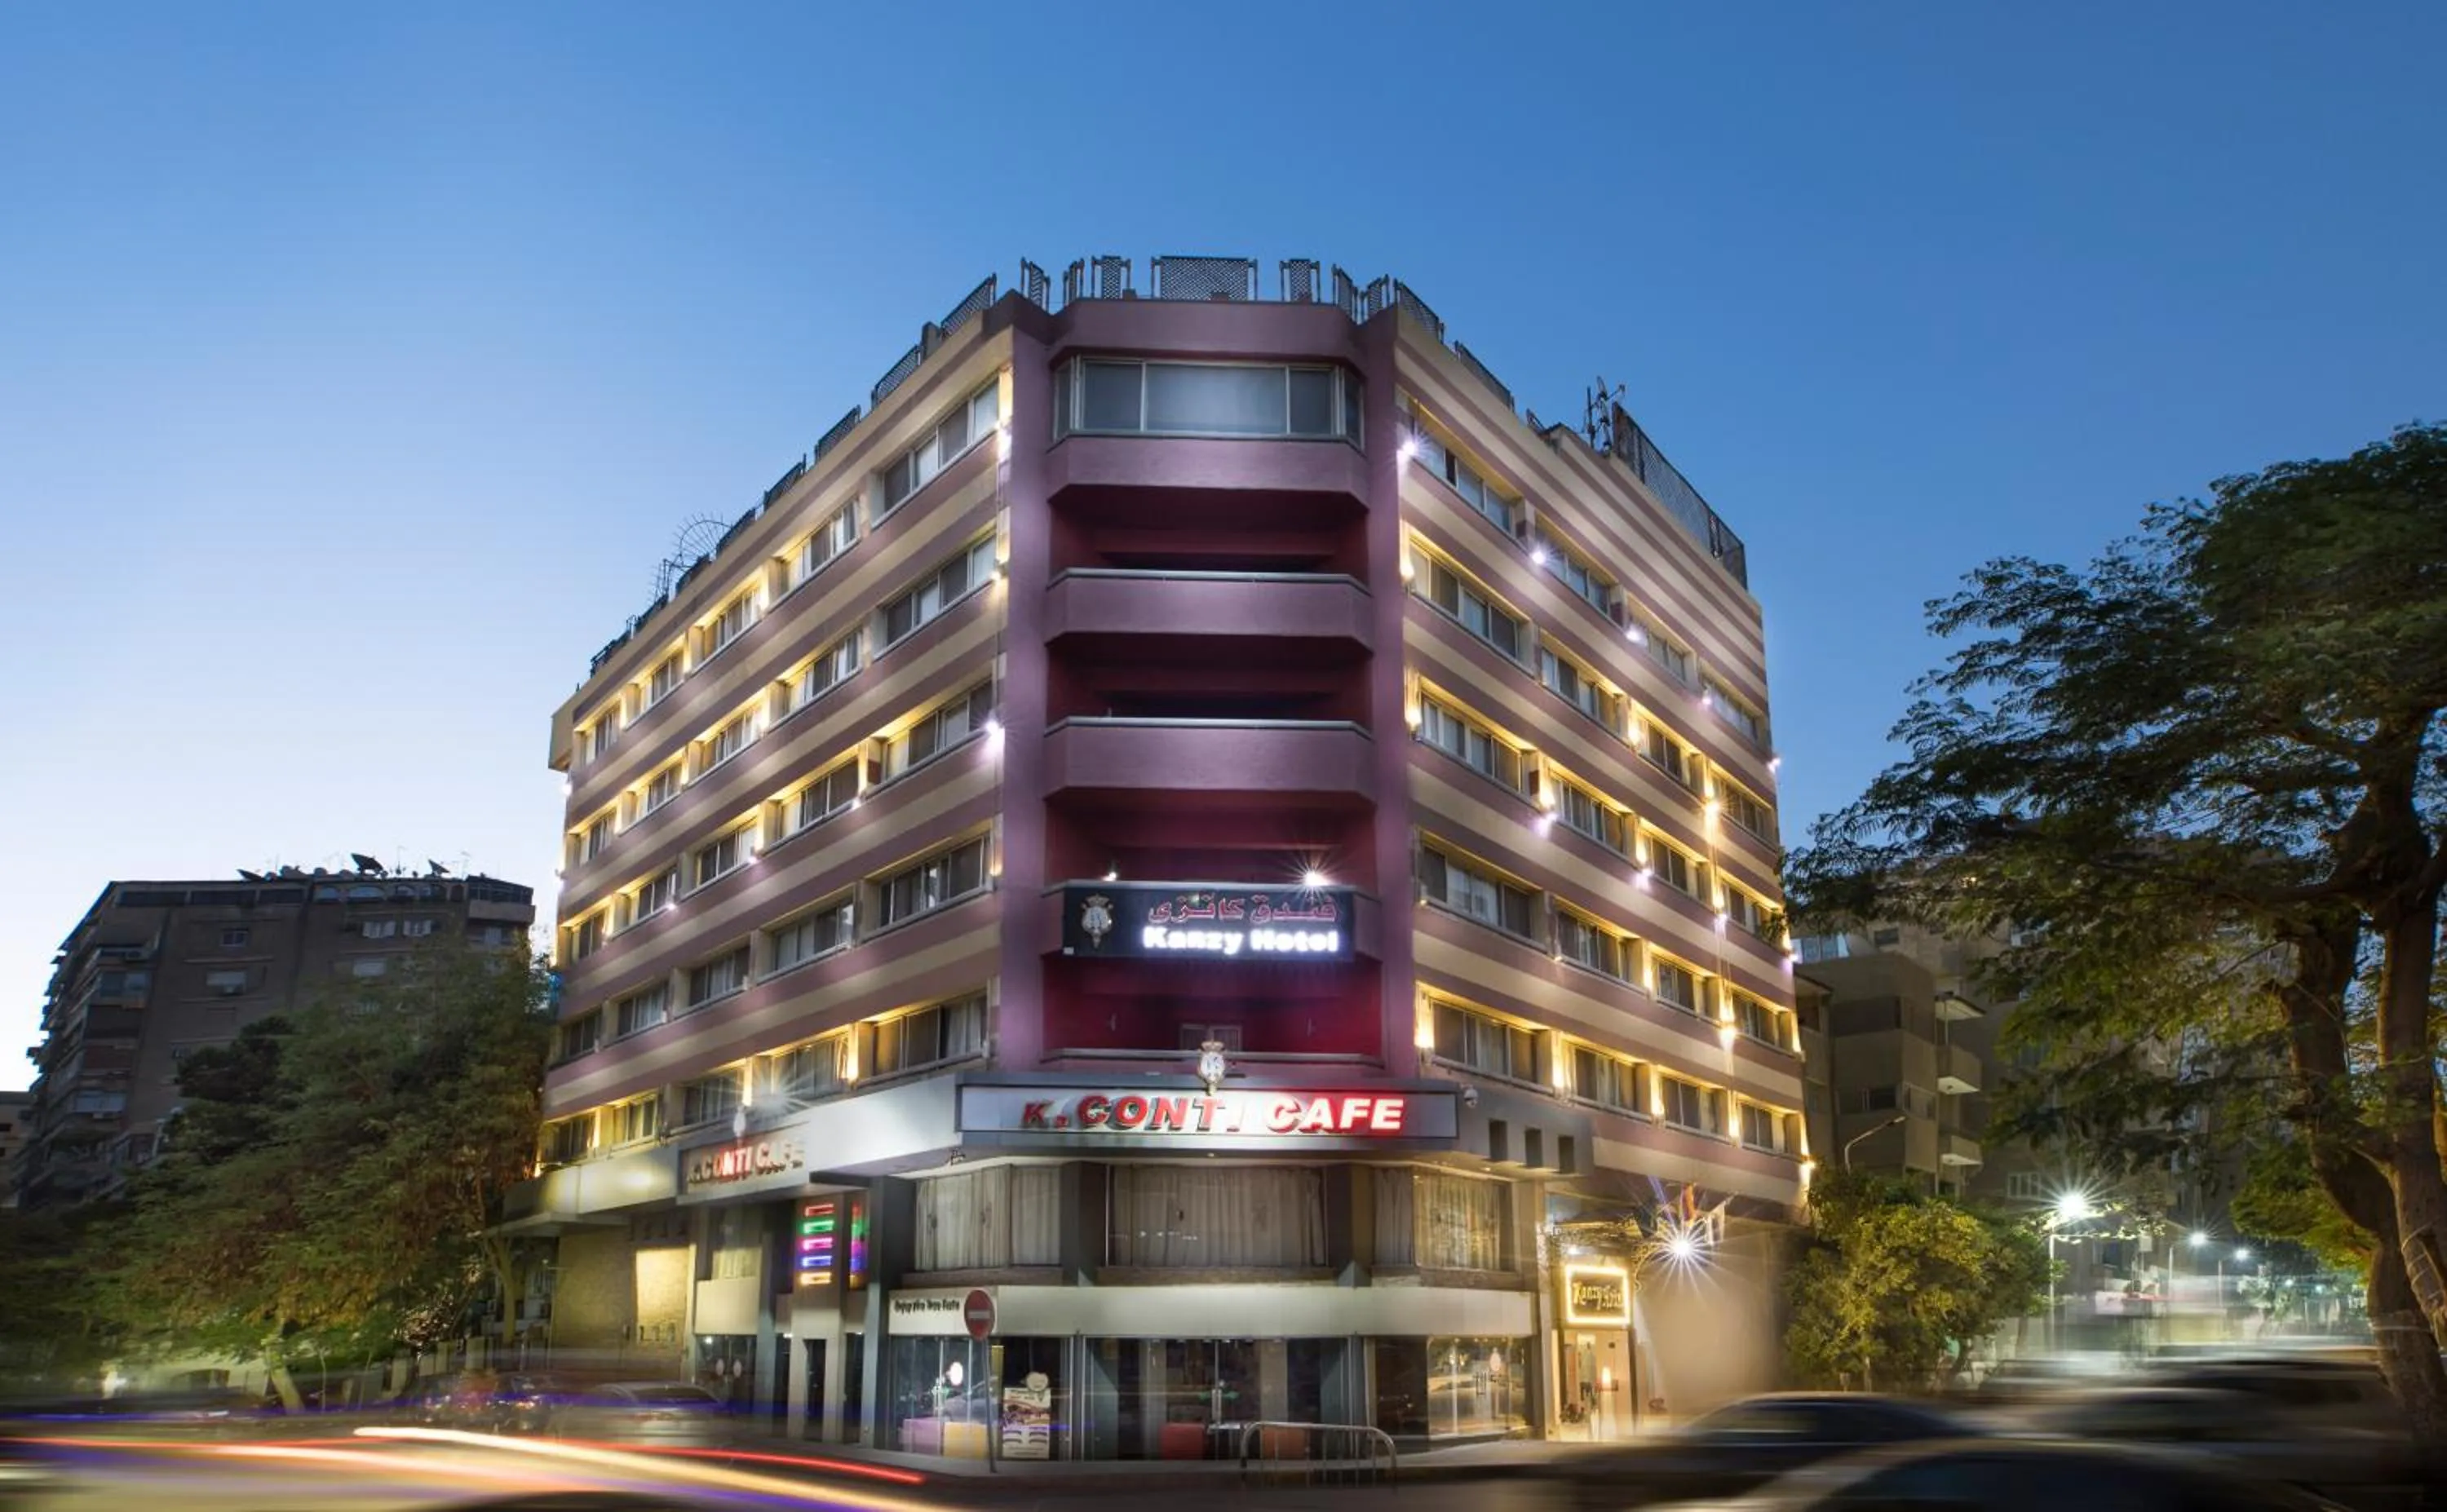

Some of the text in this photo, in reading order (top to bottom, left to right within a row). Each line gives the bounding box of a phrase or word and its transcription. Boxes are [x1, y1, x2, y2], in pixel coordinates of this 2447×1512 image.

[1250, 895, 1337, 923] فندق
[1143, 926, 1339, 955] Kanzy Hotel
[1268, 1096, 1405, 1132] CAFE
